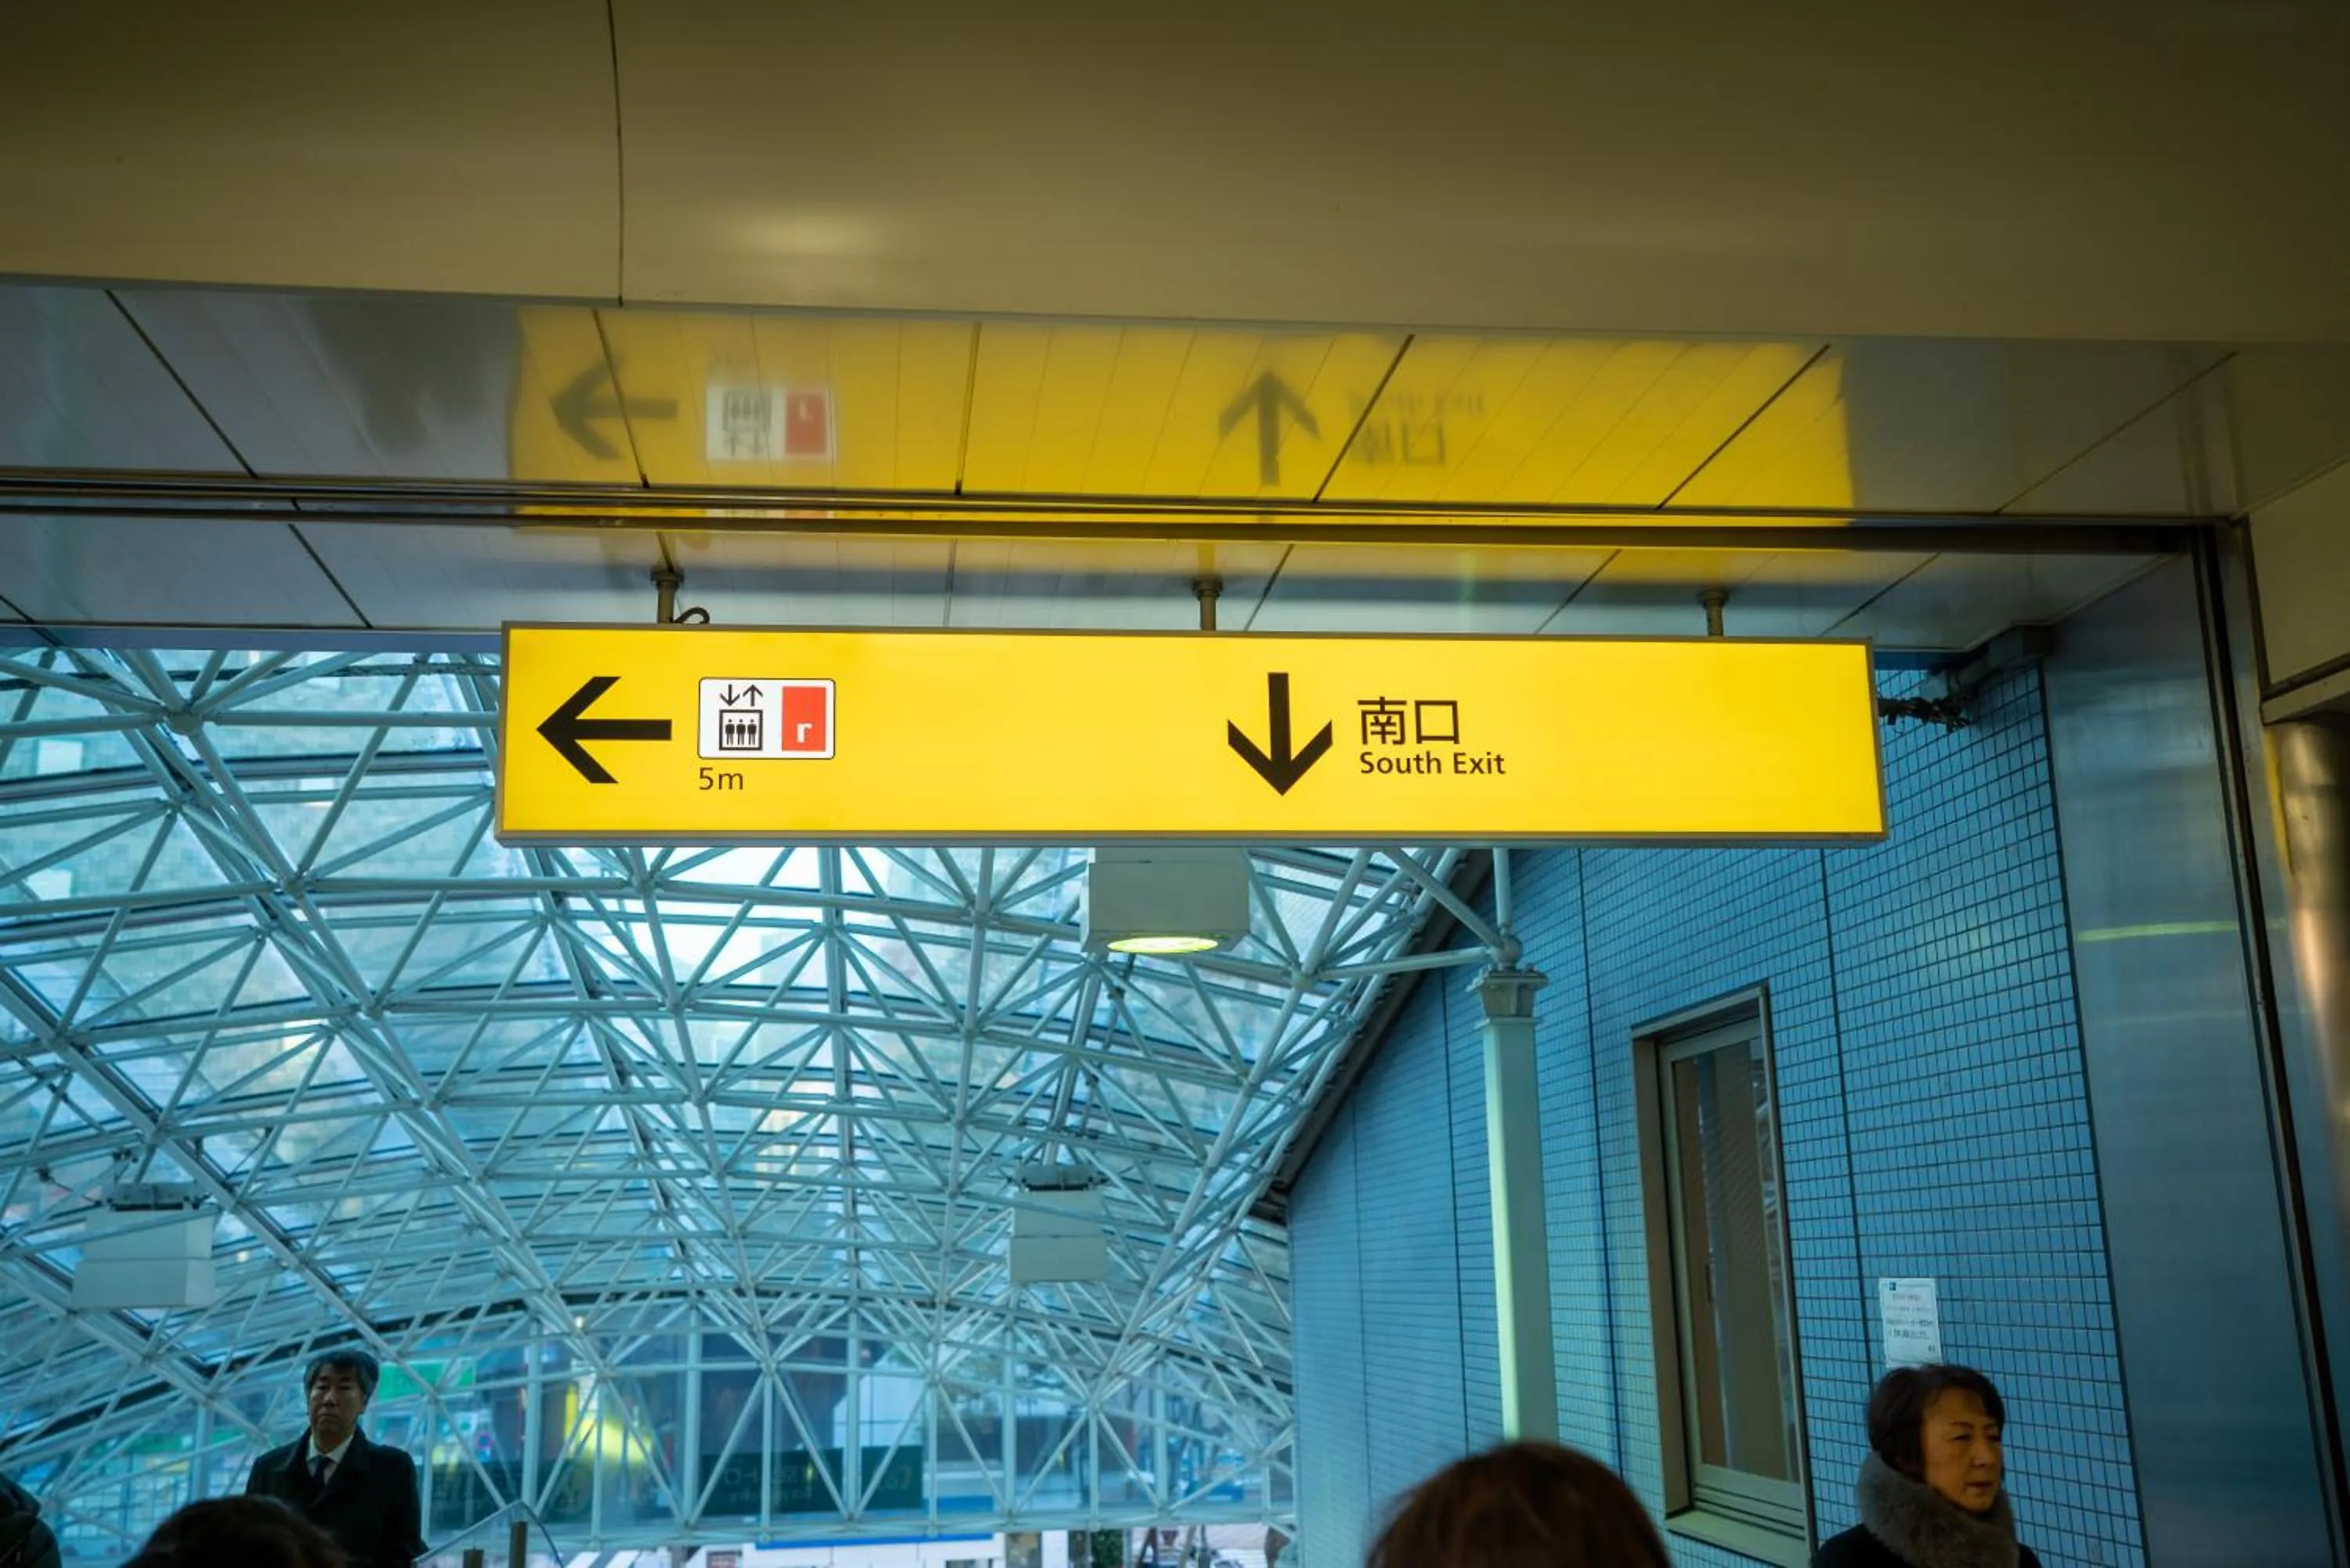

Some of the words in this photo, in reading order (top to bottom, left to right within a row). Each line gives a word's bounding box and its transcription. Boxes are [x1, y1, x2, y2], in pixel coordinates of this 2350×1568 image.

[1358, 696, 1459, 745] 南口
[797, 724, 812, 742] r
[1360, 751, 1441, 774] South
[1454, 752, 1505, 774] Exit
[700, 768, 743, 789] 5m
